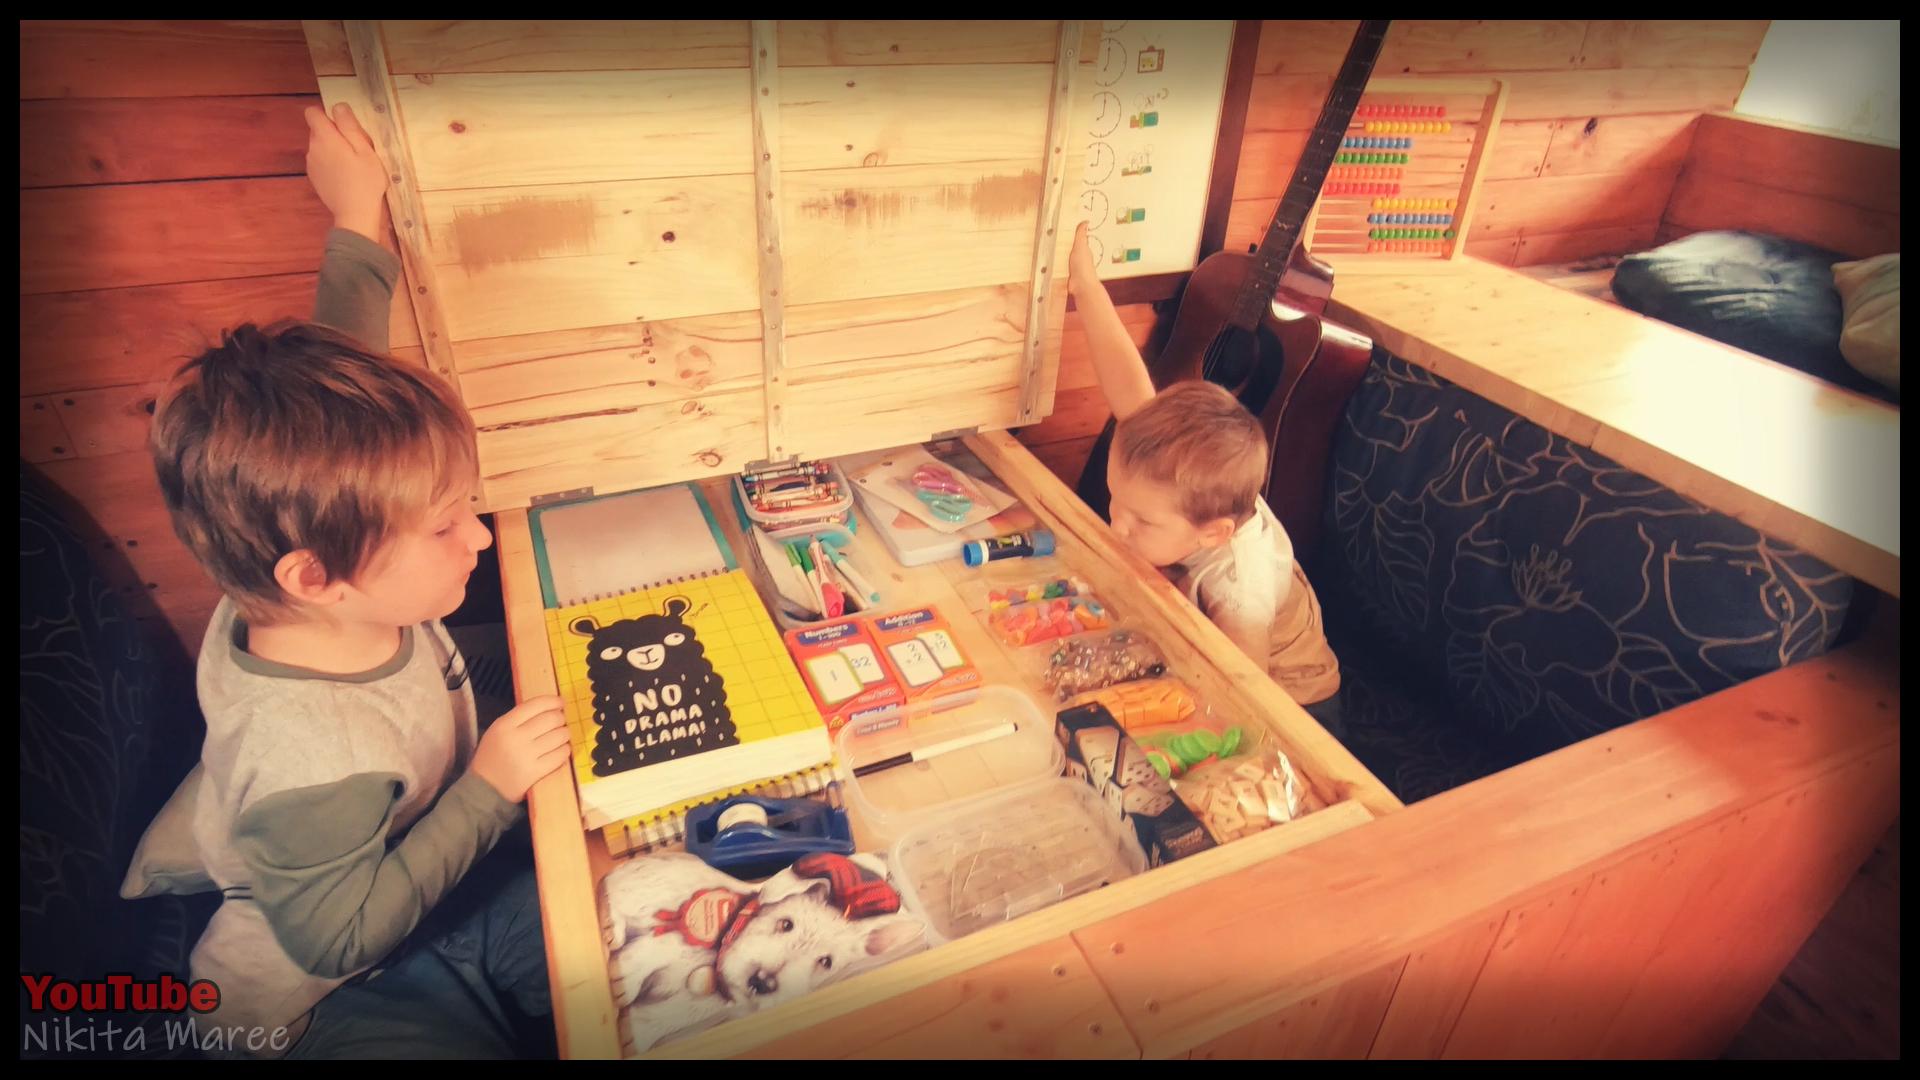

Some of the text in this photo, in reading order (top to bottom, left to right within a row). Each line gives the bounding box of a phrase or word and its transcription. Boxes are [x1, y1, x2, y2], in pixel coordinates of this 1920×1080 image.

[804, 623, 849, 639] Numbers
[633, 683, 682, 715] NO
[624, 703, 703, 735] DRAMA
[634, 720, 706, 750] LLAMA!
